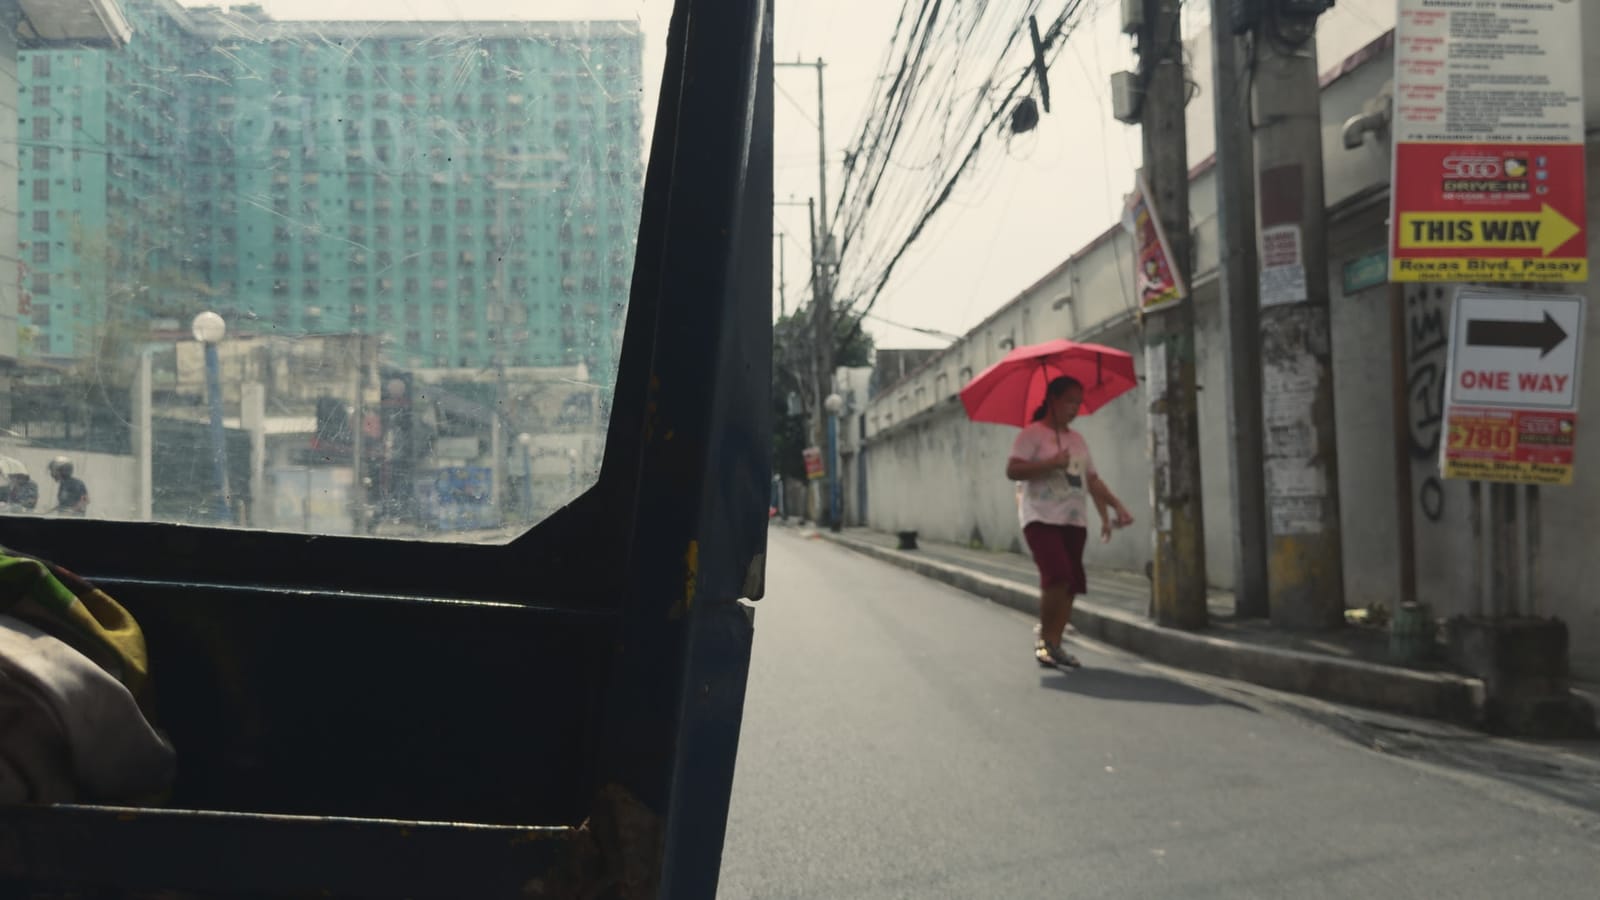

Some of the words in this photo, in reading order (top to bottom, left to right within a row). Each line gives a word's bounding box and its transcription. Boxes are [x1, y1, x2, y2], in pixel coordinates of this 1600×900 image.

[1411, 220, 1474, 242] THIS
[1481, 220, 1541, 242] WAY
[1399, 259, 1460, 271] Roxas
[1522, 259, 1582, 272] Pasay
[1460, 369, 1511, 391] ONE
[1517, 373, 1569, 393] WAY
